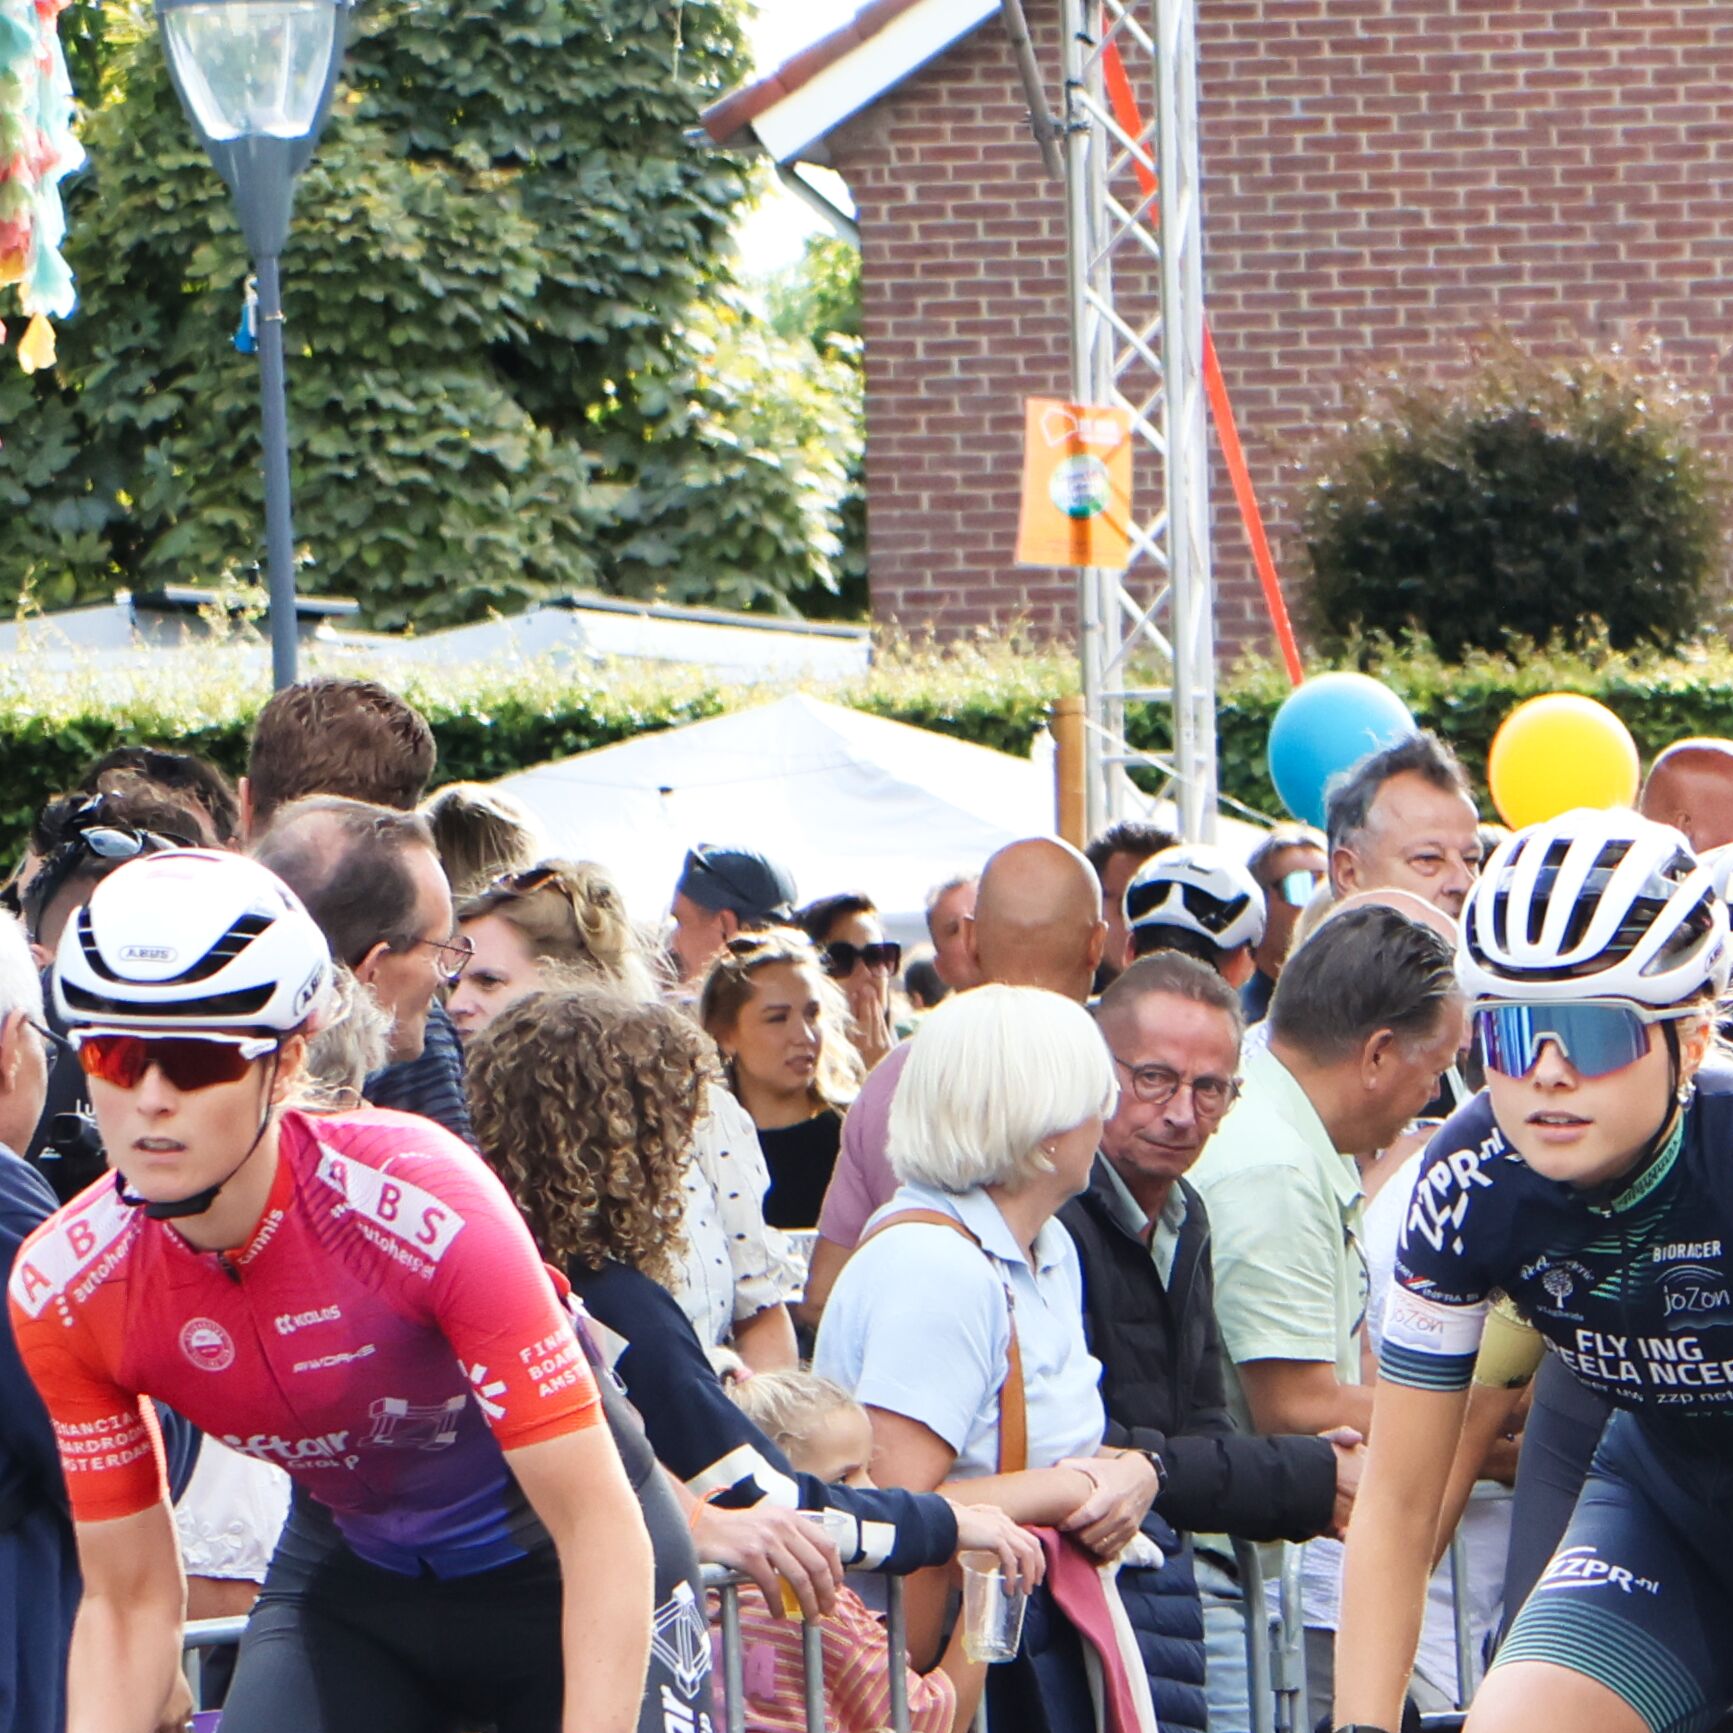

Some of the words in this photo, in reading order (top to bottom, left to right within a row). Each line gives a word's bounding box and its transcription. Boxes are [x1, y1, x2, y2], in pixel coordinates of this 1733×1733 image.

[1407, 1126, 1506, 1252] ZZPR.nl
[1652, 1240, 1722, 1263] BIORACER
[1663, 1284, 1731, 1317] joZon
[1575, 1328, 1705, 1362] FLYING
[1655, 1393, 1694, 1405] zzp
[1541, 1556, 1660, 1596] ZZPR.nl
